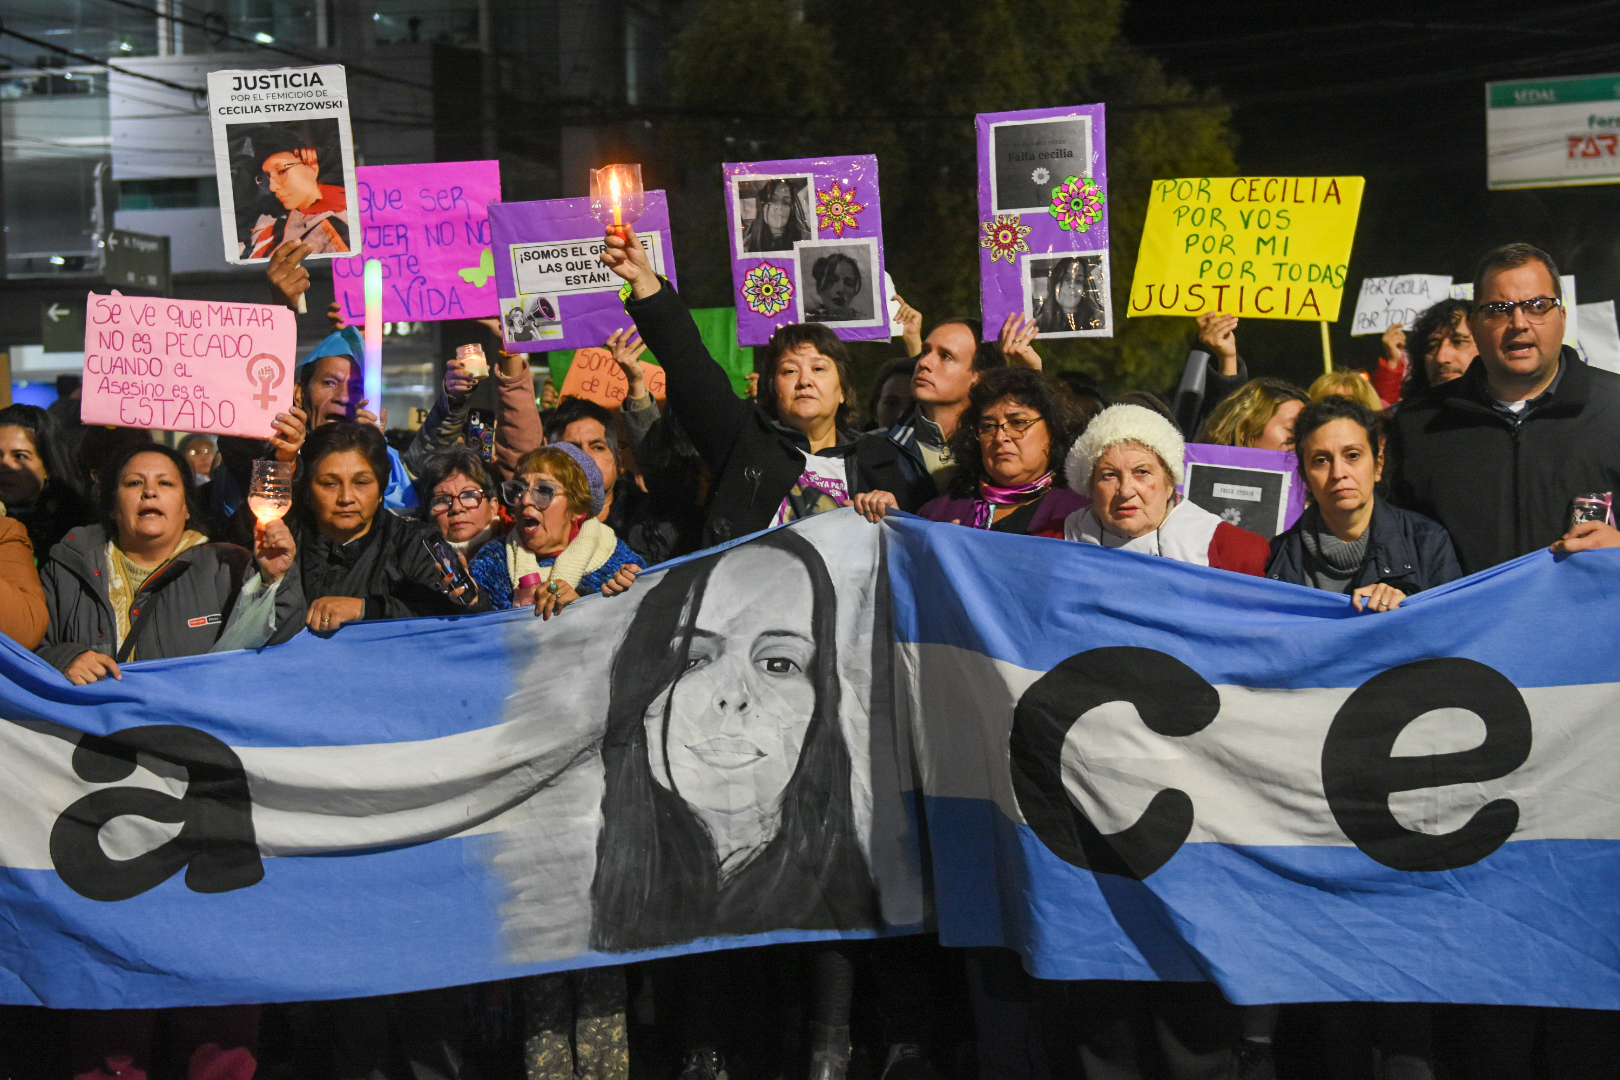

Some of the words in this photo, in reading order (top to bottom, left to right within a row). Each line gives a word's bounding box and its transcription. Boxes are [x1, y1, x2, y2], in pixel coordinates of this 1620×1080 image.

[232, 72, 324, 91] JUSTICIA
[218, 104, 262, 115] CECILIA
[264, 100, 343, 113] STRZYZOWSKI
[230, 94, 251, 102] POR
[253, 93, 263, 101] EL
[266, 91, 314, 100] FEMICIDIO
[315, 90, 328, 98] DE
[1008, 151, 1035, 162] Falta
[1038, 148, 1073, 160] cecilia
[1156, 178, 1212, 203] POR
[1230, 178, 1341, 205] CECILIA
[1173, 205, 1227, 231] POR
[1239, 208, 1291, 230] VOS
[425, 221, 455, 247] NO
[1185, 233, 1236, 256] POR
[1256, 235, 1289, 257] MI
[519, 247, 569, 264] ¡SOMOS
[572, 245, 587, 257] EL
[538, 262, 563, 274] LAS
[565, 260, 592, 272] QUE
[565, 272, 610, 286] ESTÁN!
[1199, 259, 1256, 283] POR
[1272, 262, 1348, 289] TODAS
[1132, 283, 1321, 317] JUSTICIA
[207, 304, 273, 330] MATAR
[99, 330, 124, 351] NO
[166, 332, 253, 358] PECADO
[87, 354, 162, 377] CUANDO
[97, 376, 164, 397] Asesino
[120, 397, 235, 428] ESTADO
[50, 725, 265, 901] a
